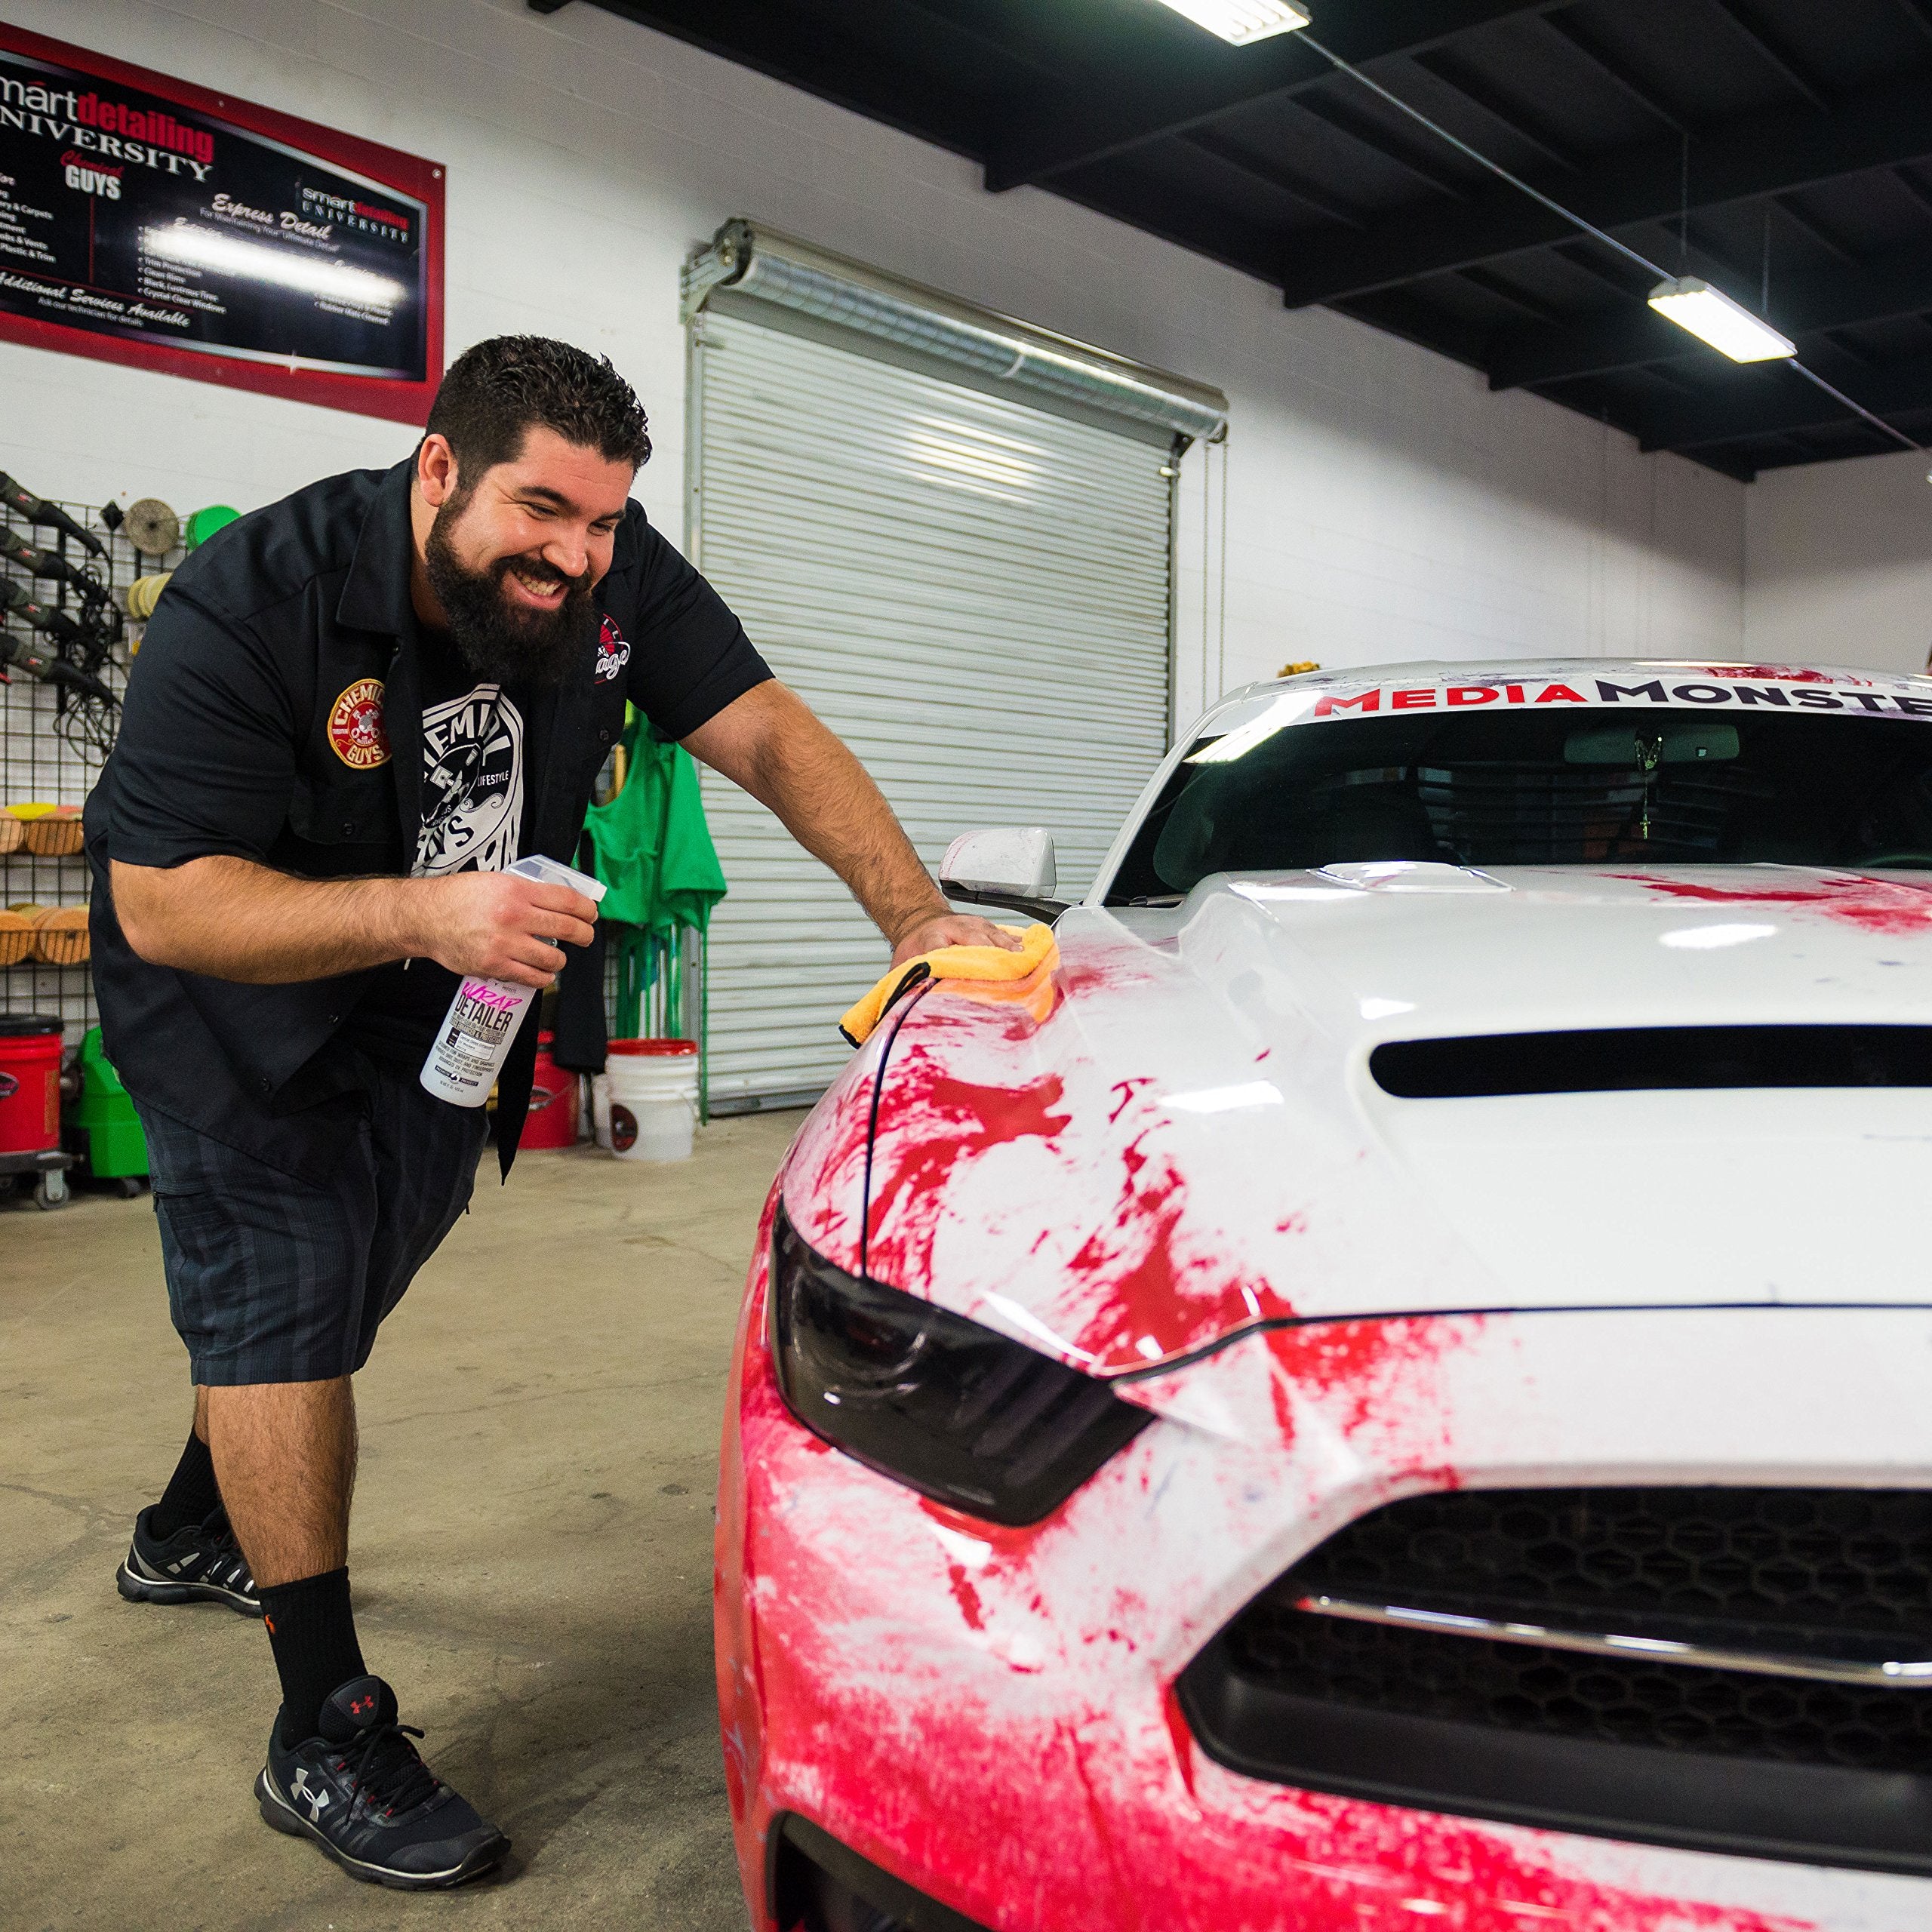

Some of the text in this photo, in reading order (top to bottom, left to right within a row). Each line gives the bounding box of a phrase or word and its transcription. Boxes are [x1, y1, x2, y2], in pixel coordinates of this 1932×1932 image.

[65, 165, 122, 201] GUYS
[212, 193, 334, 241] Express Detail
[303, 200, 408, 244] UNIVERSITY
[70, 288, 125, 312] Services
[127, 303, 191, 328] Available
[347, 744, 385, 764] GUYS
[478, 770, 509, 787] LIFESTYLE
[455, 993, 513, 1032] DETAILER
[462, 982, 523, 1011] WRAP
